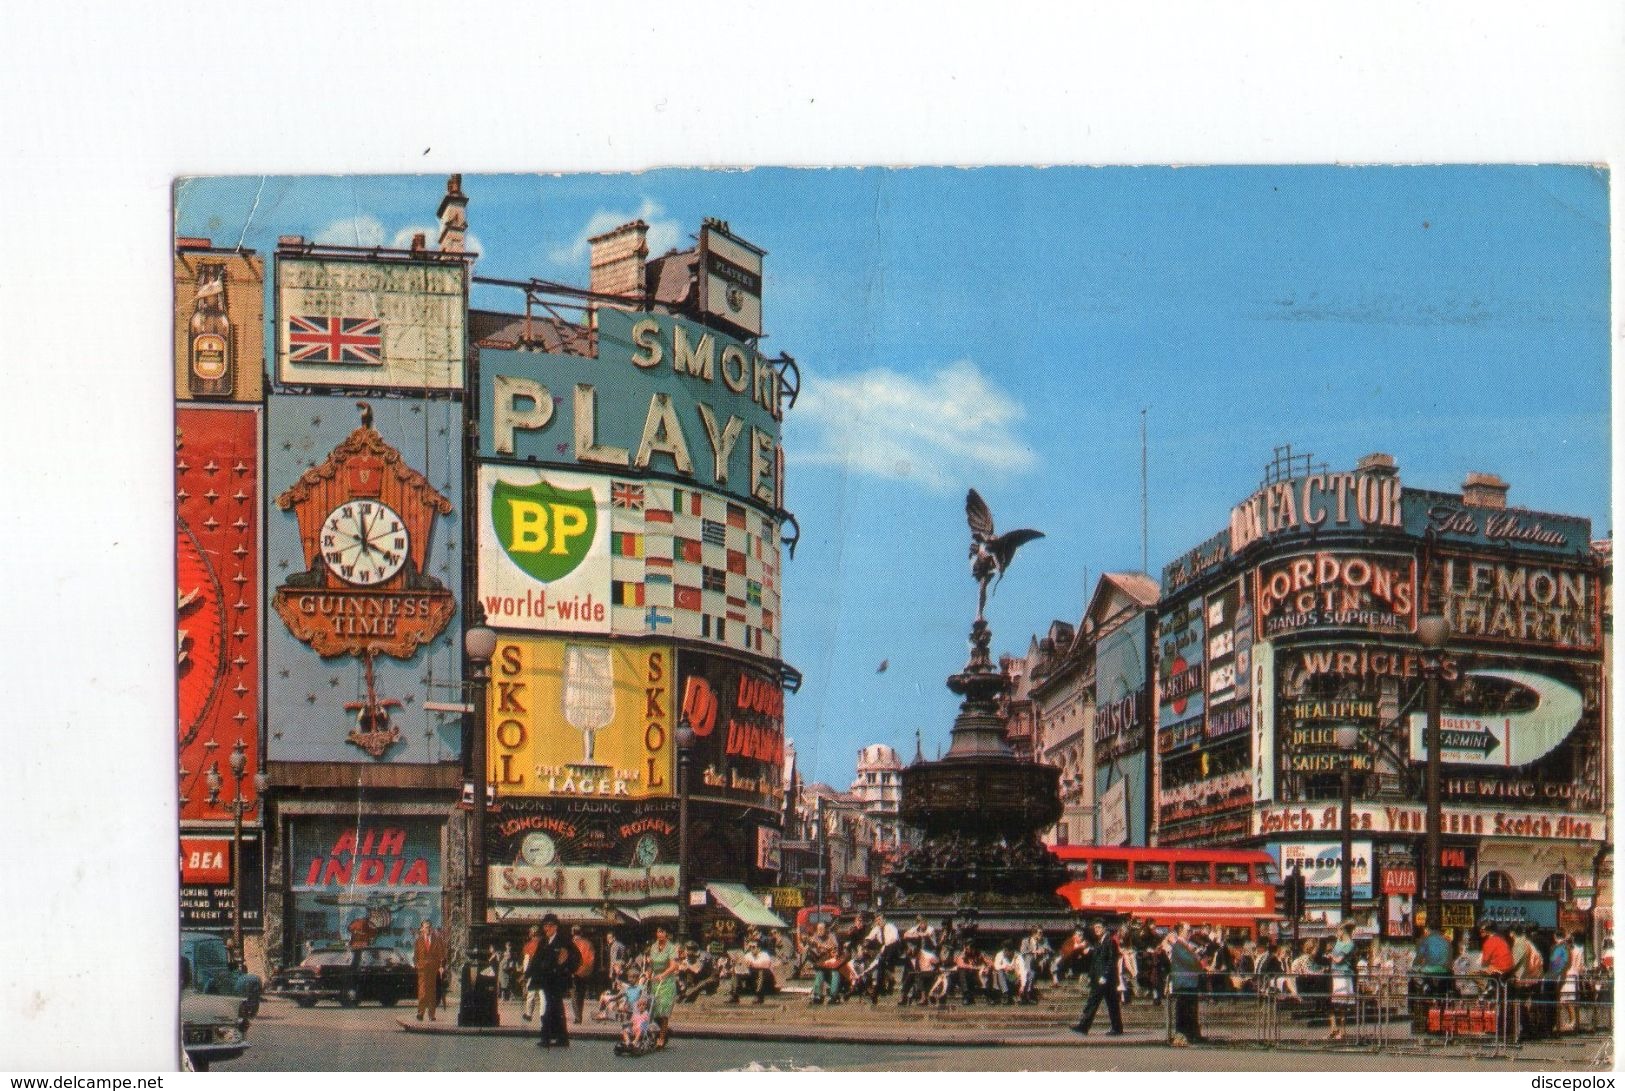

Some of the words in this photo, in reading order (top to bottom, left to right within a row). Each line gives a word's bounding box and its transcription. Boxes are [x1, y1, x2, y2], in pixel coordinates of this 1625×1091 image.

[1266, 471, 1401, 532] FACTOR
[508, 499, 589, 555] BP
[1260, 550, 1412, 615] GORDON'S
[1442, 557, 1587, 612] LEMON
[298, 595, 431, 617] GUINNESS
[485, 589, 605, 622] world-wide
[331, 615, 397, 637] TIME
[1267, 610, 1318, 631] STANDS
[1159, 666, 1200, 700] MARTINI
[496, 645, 527, 787] SKOL
[644, 651, 665, 789] SKOL
[1093, 692, 1139, 744] BRISTOL
[1440, 717, 1481, 730] IGLEY'S
[1293, 726, 1368, 744] DELICIS
[548, 776, 630, 796] LAGER
[567, 801, 622, 814] LEADING
[1260, 806, 1313, 833] Scotch
[1319, 806, 1371, 830] Aes
[500, 815, 576, 839] LONGINES
[620, 817, 673, 838] ROTARY
[1493, 811, 1551, 837] Scotch
[331, 827, 408, 856] AIR
[189, 850, 223, 869] BEA
[305, 856, 430, 886] INDIA
[1386, 869, 1414, 887] AVIA
[213, 888, 237, 897] OFFIC
[218, 900, 235, 909] HAL
